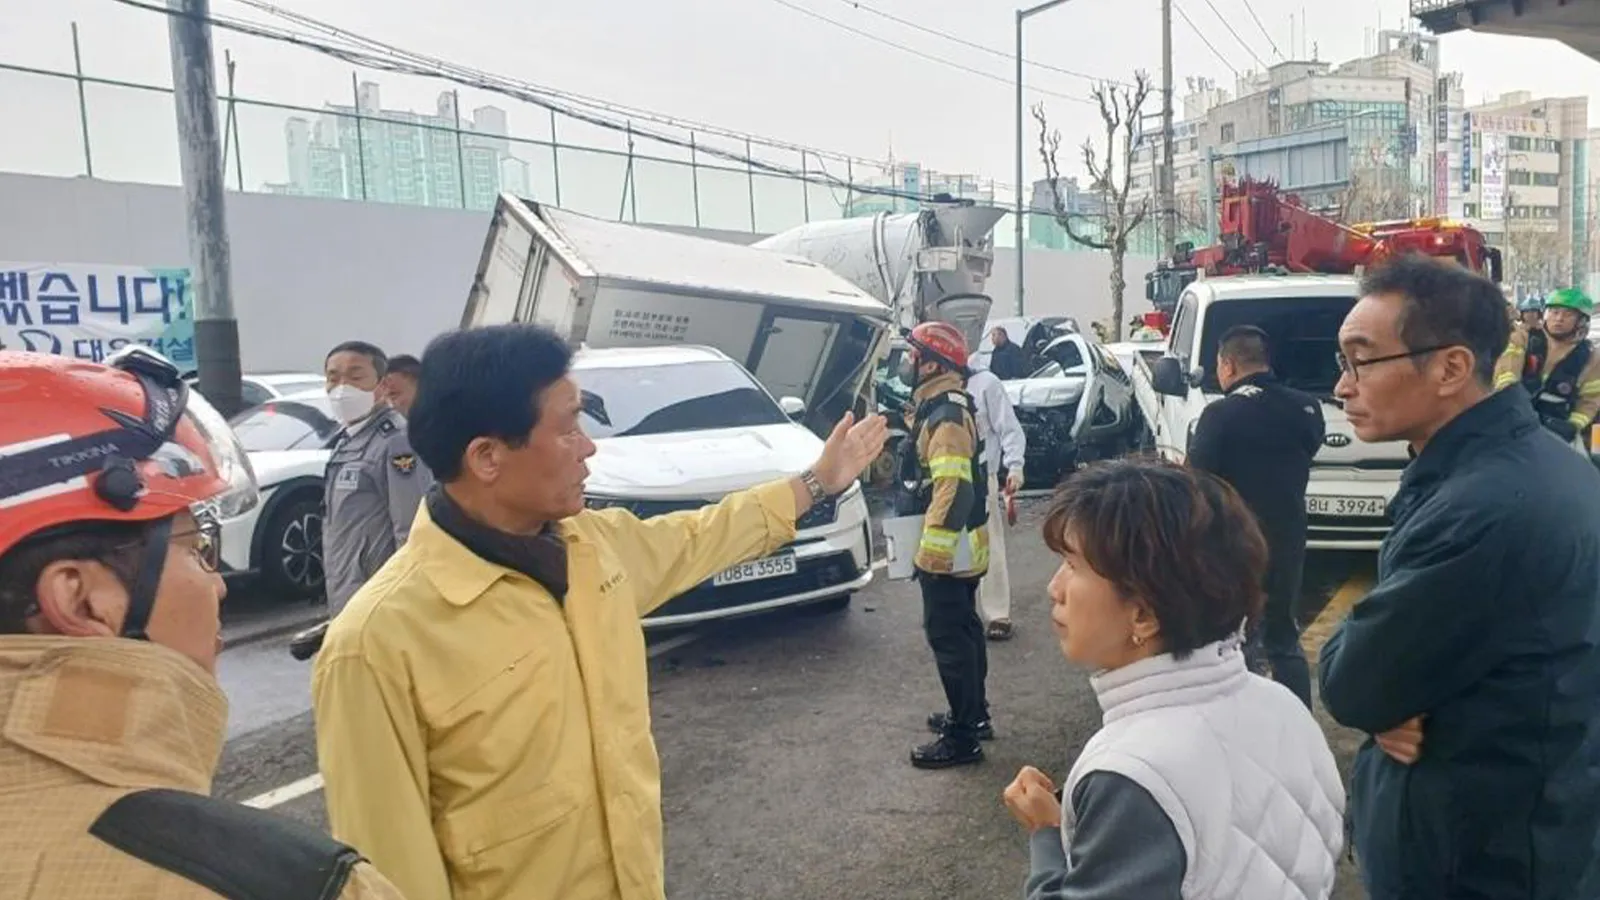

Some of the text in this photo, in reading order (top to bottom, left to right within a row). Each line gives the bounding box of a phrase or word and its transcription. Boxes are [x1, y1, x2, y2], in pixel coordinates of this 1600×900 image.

[1326, 435, 1348, 445] KIA
[1335, 499, 1377, 514] 3994
[757, 557, 793, 576] 3555
